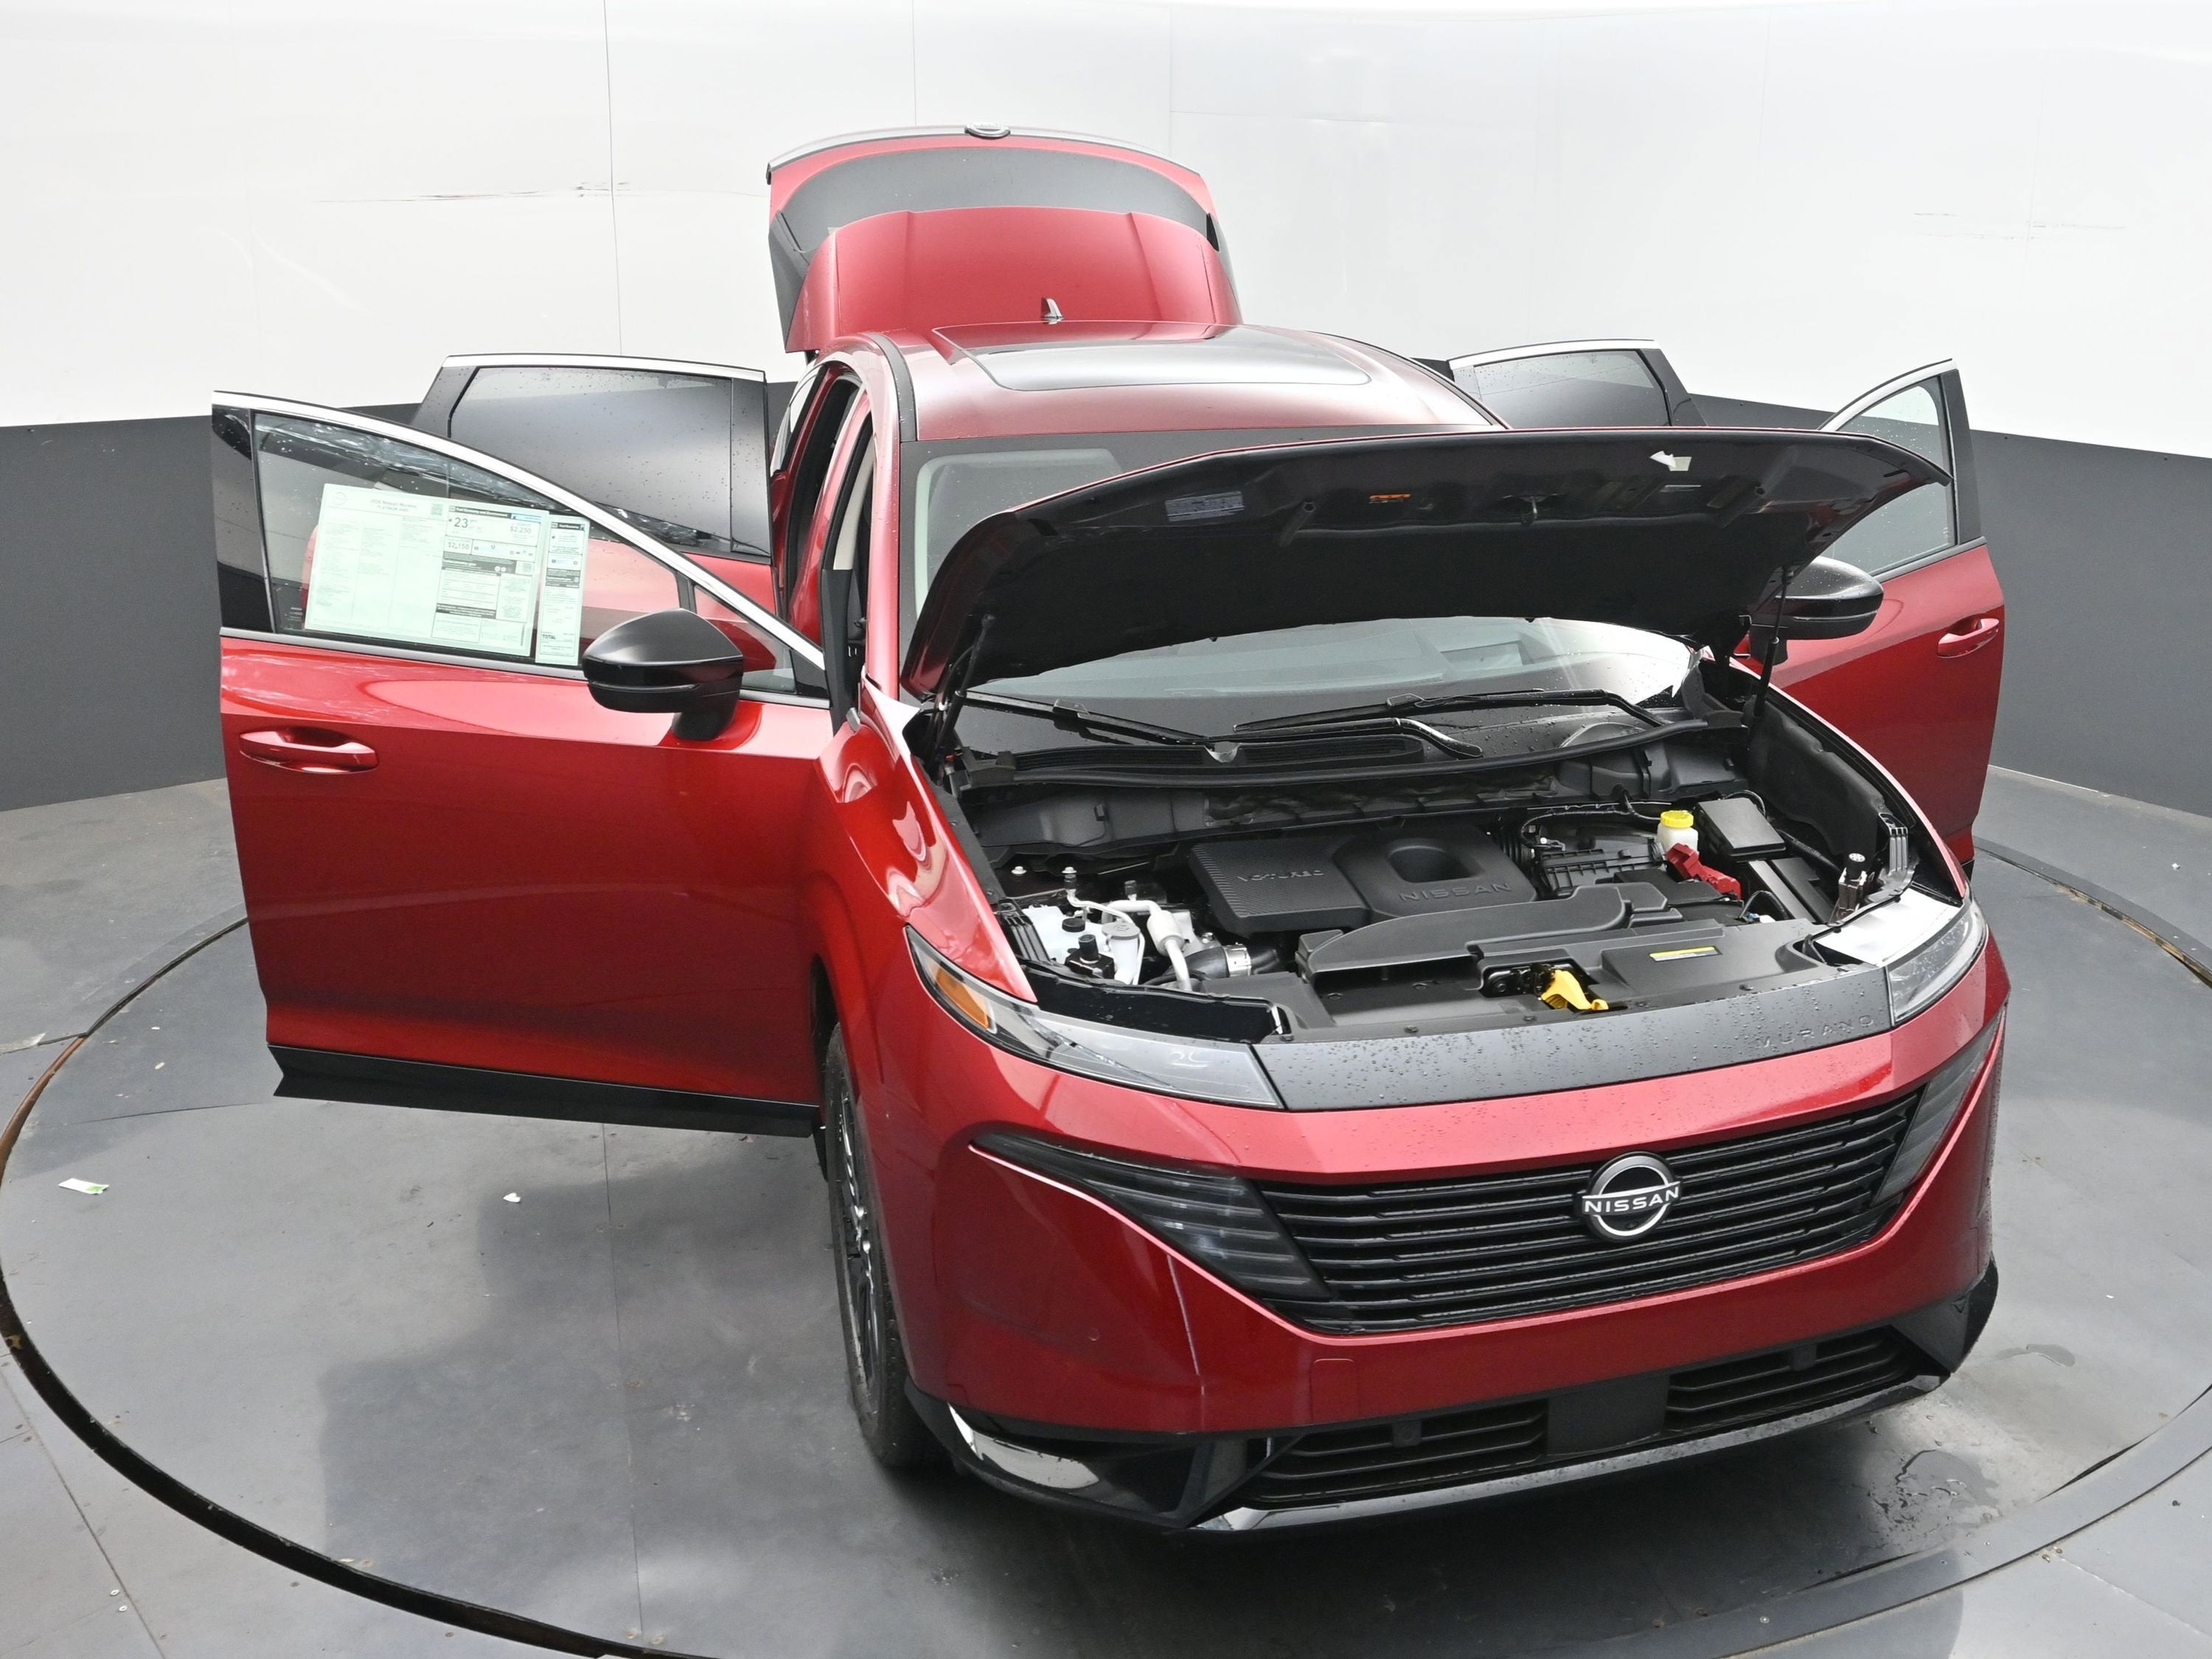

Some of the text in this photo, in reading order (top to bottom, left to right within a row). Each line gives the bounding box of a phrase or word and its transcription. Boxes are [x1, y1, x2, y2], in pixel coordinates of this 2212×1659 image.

[453, 517, 469, 529] 23
[1397, 881, 1514, 902] NISSAN
[1756, 1015, 1875, 1048] MURANO
[1584, 1181, 1680, 1214] NISSAN
